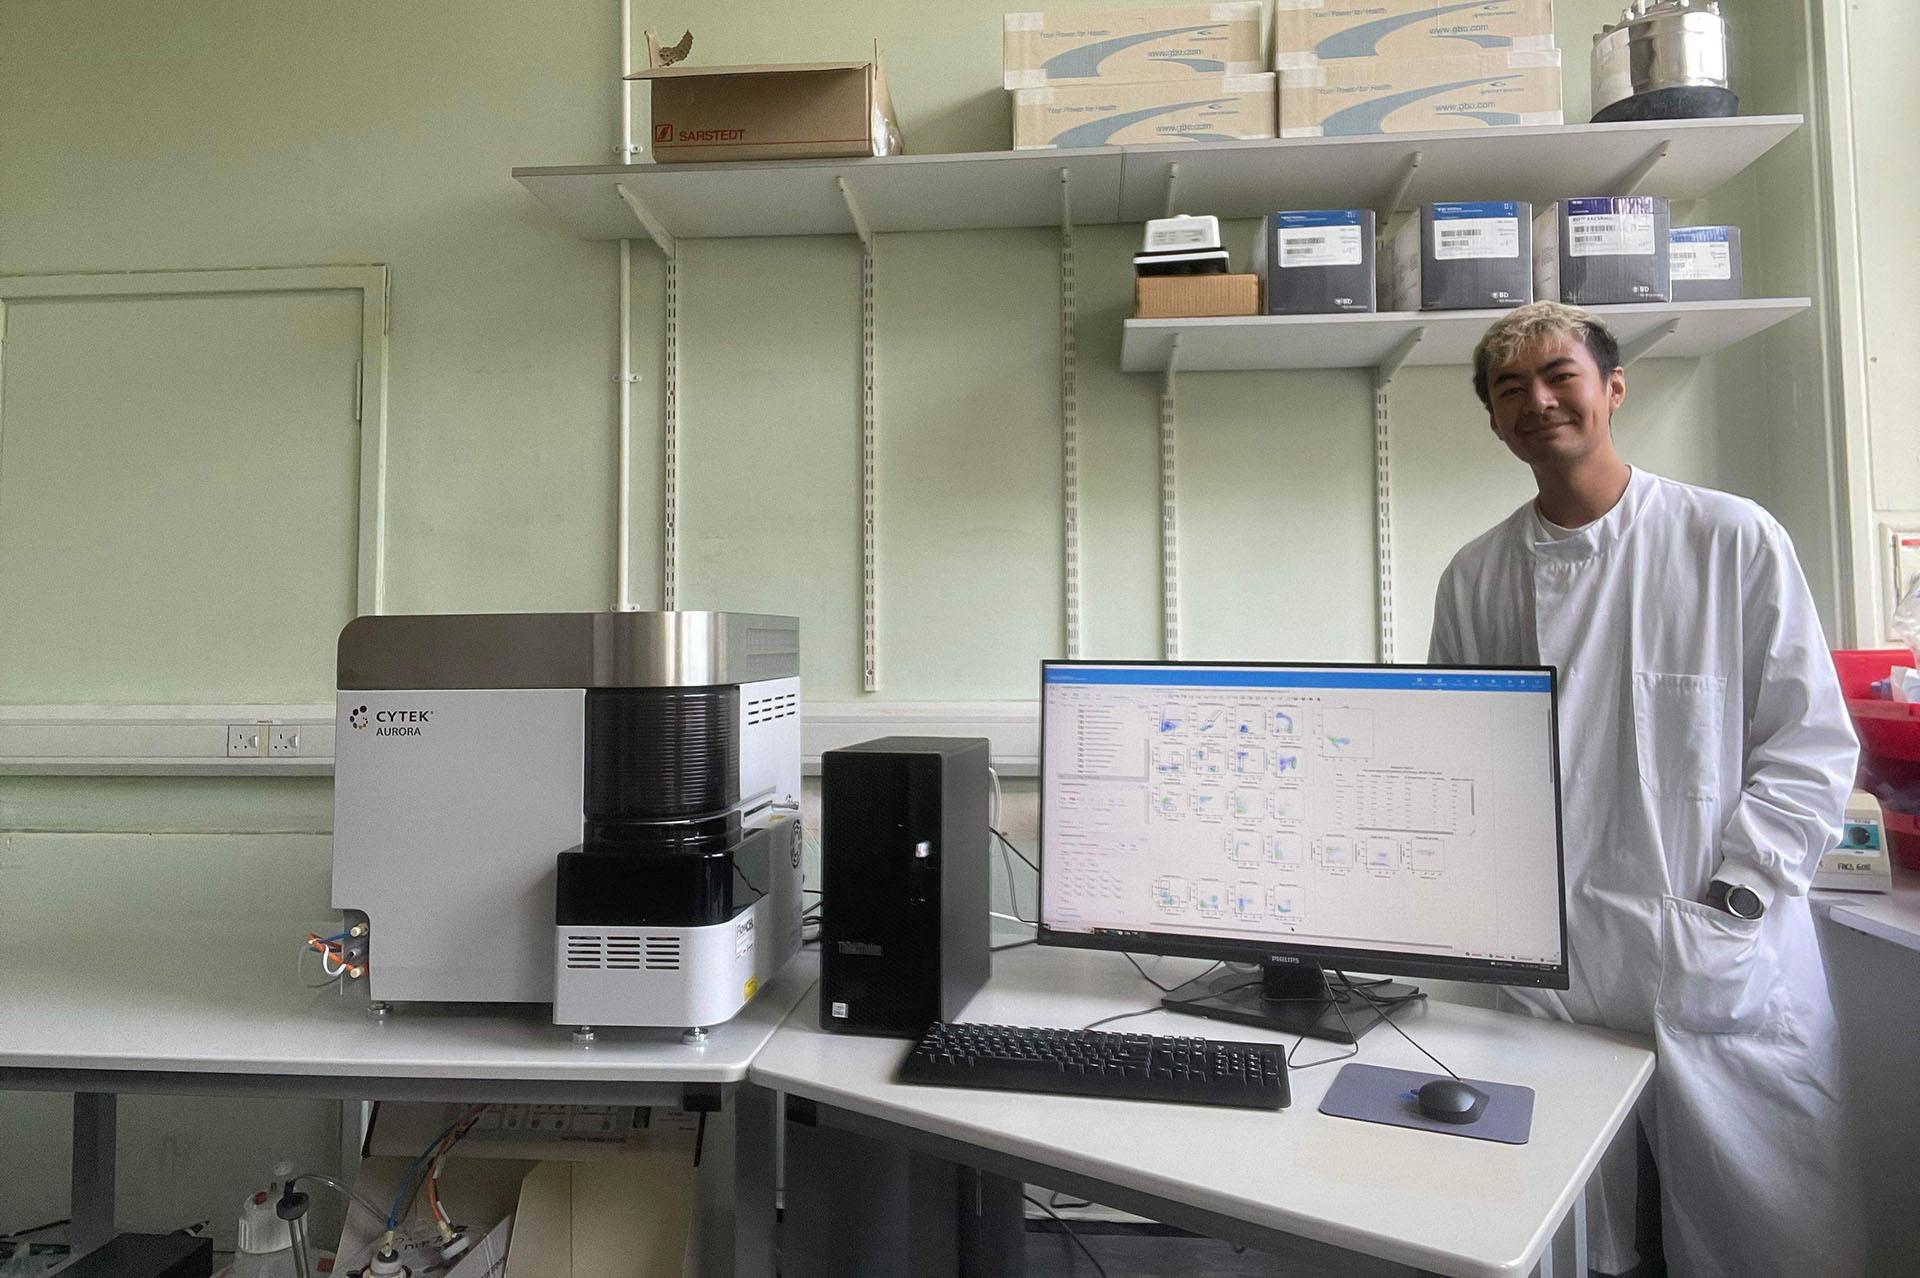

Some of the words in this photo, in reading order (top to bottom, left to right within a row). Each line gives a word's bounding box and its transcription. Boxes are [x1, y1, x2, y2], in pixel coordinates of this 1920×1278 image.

[1429, 24, 1489, 35] www.gbo.com
[1435, 101, 1496, 112] www.gbo.com
[679, 129, 745, 142] SARSTEDT
[376, 711, 429, 722] CYTEK
[376, 727, 421, 736] AURORA
[1271, 955, 1300, 964] PHILIPS
